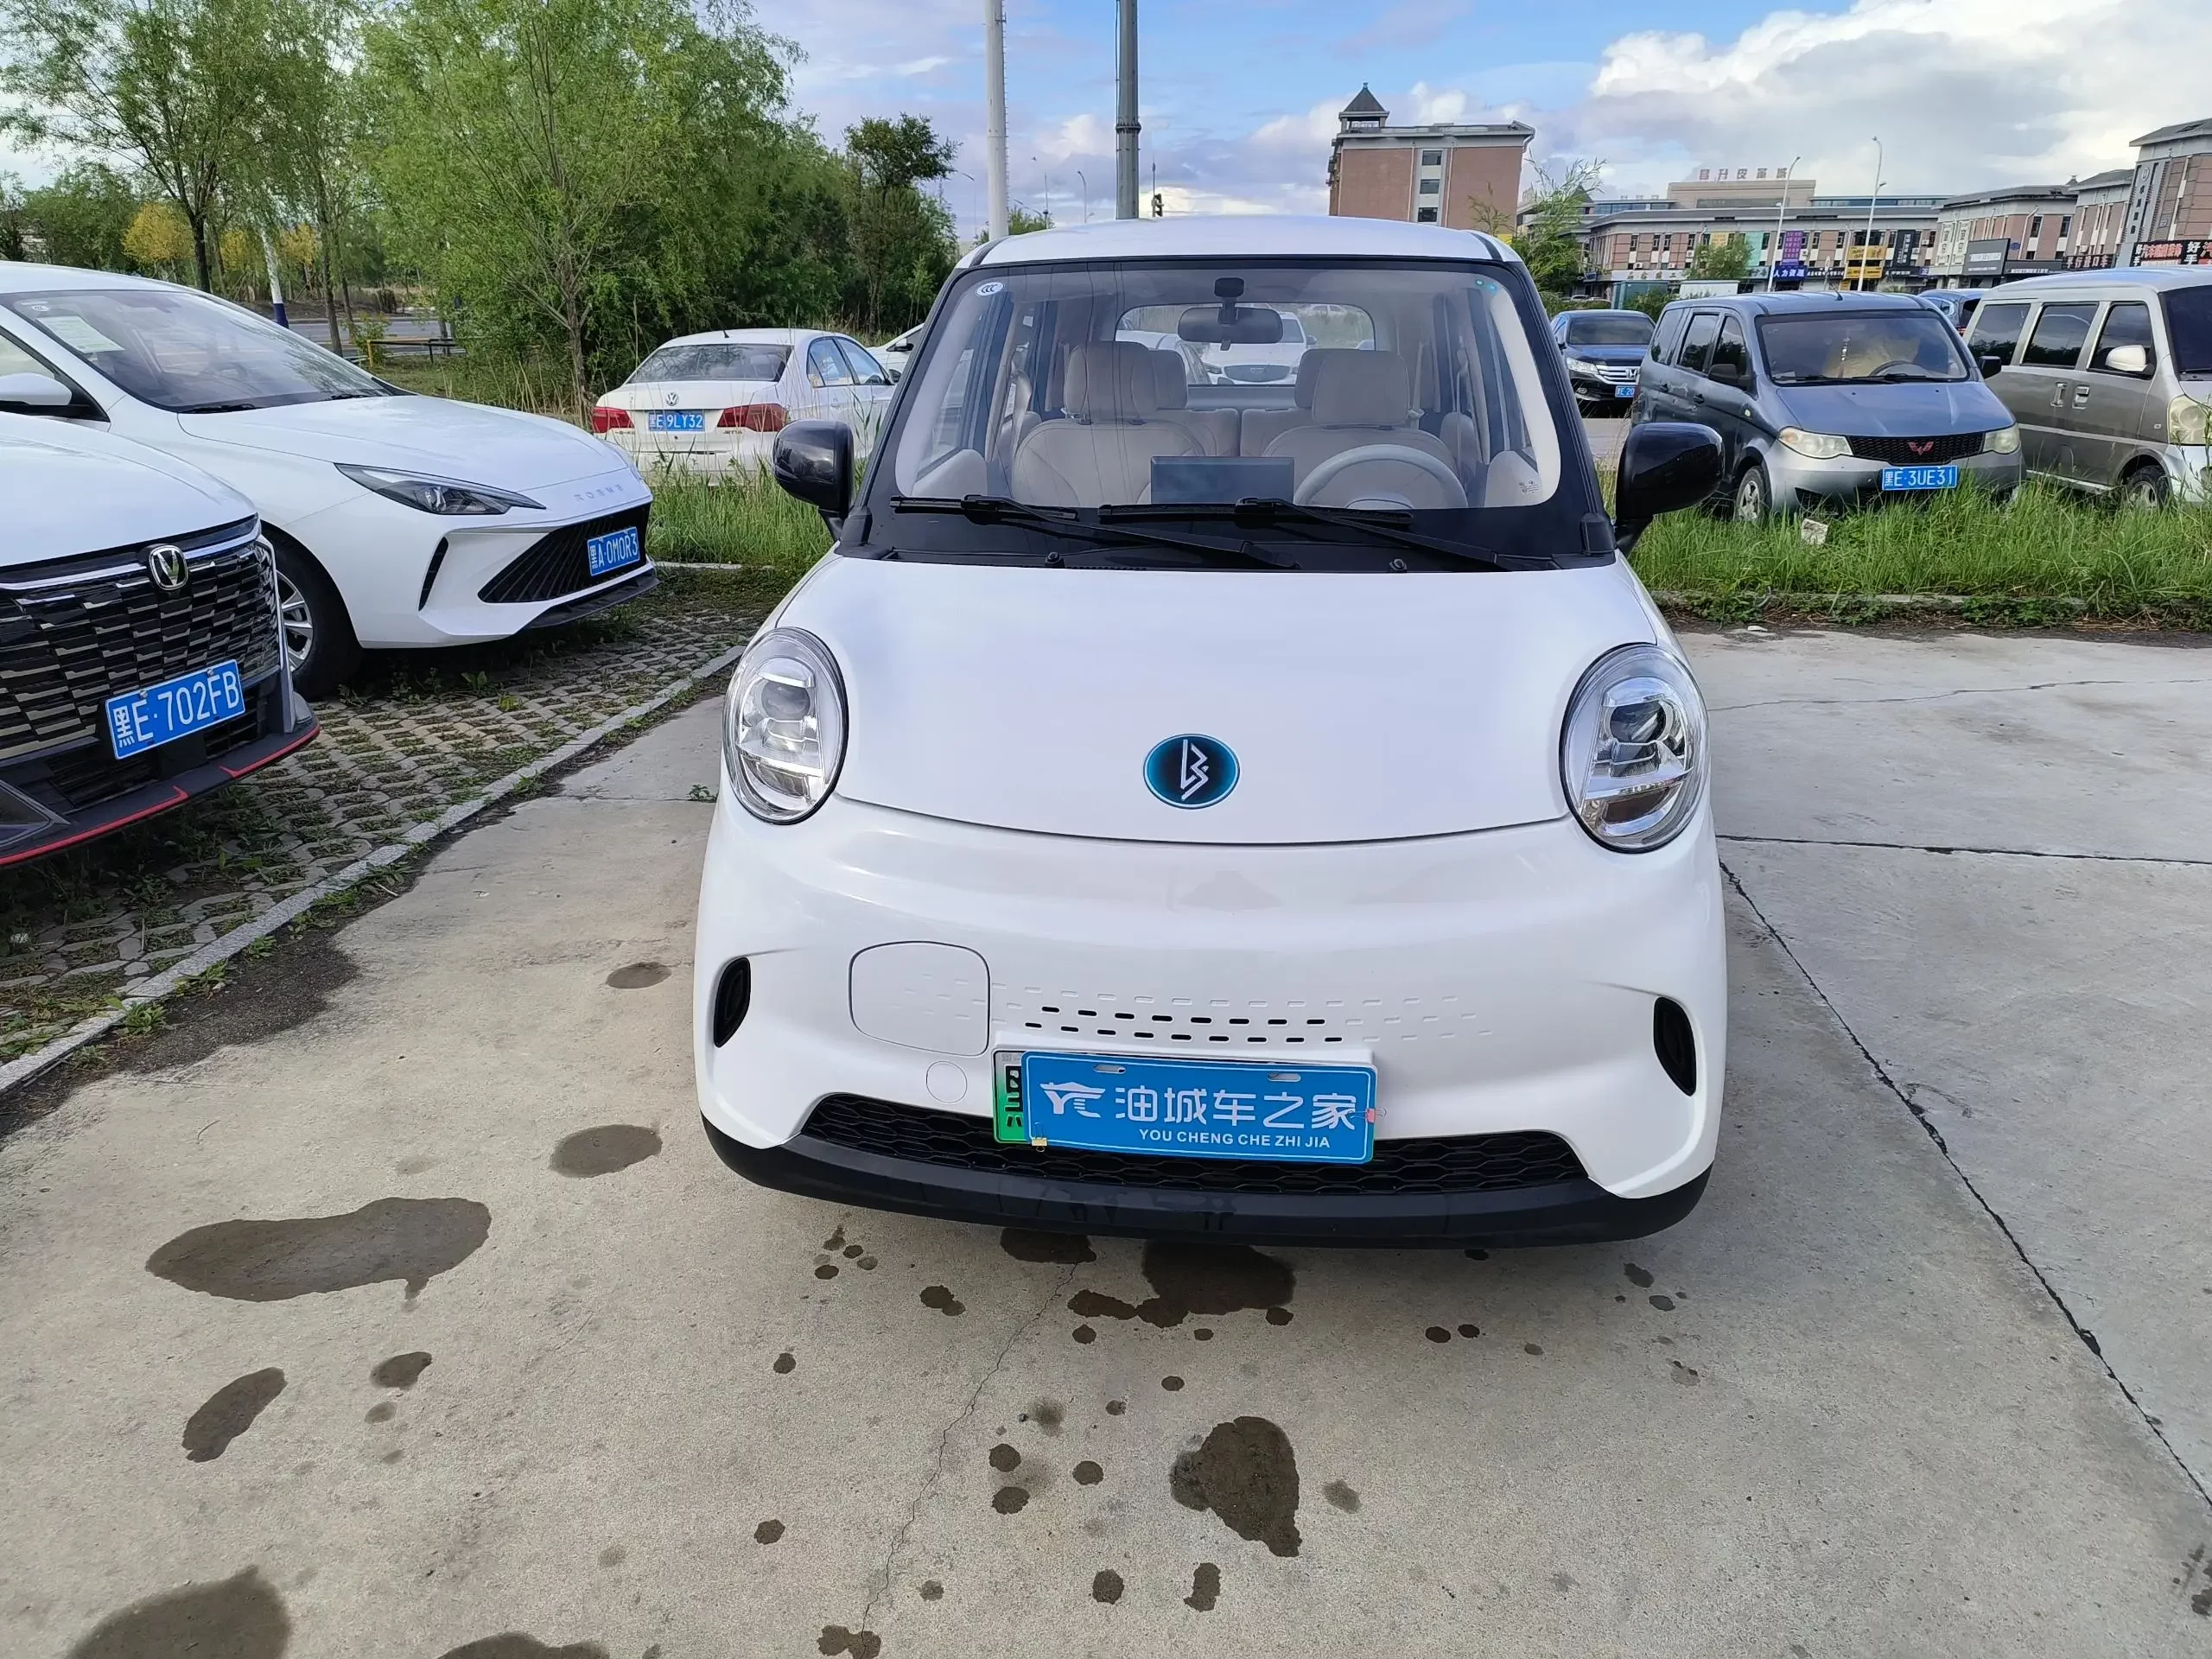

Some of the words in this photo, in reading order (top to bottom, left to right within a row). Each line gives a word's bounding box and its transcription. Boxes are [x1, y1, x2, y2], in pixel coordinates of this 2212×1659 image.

[1115, 1084, 1357, 1131] 油城车之家
[1139, 1128, 1173, 1141] YOU
[1176, 1131, 1234, 1145] CHENG
[1237, 1134, 1271, 1147] CHE
[1274, 1135, 1301, 1147] ZHI
[1305, 1136, 1331, 1148] JIA
